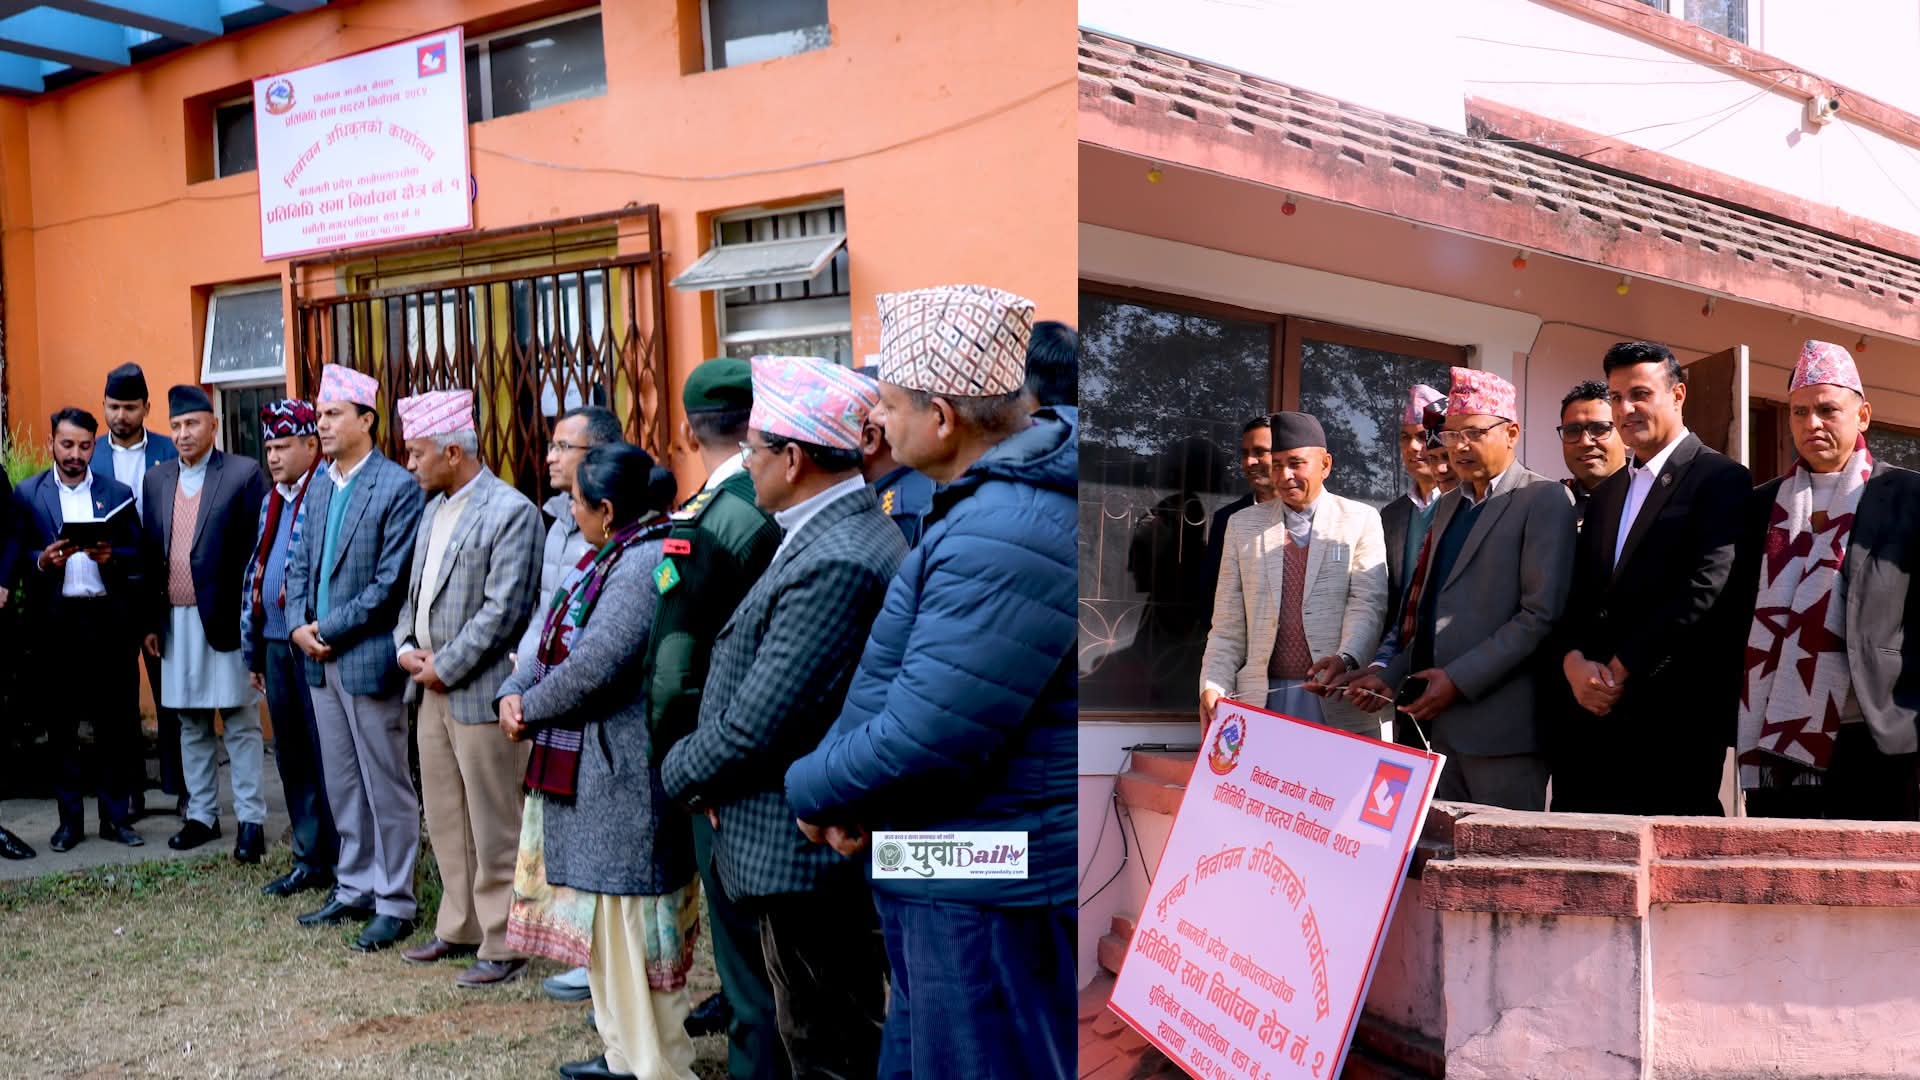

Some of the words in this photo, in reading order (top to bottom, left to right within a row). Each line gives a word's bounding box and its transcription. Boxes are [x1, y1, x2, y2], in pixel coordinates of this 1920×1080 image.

[283, 140, 321, 189] निर्वाचन
[326, 117, 383, 146] अधिकृतको
[388, 122, 436, 162] कार्यालय
[266, 200, 314, 225] प्रतिनिधि
[318, 197, 344, 216] सभा
[347, 188, 397, 210] निर्वाचन
[402, 182, 427, 201] क्षेत्र
[1213, 781, 1247, 811] प्रतिनिधि
[1246, 796, 1265, 818] सभा
[1265, 804, 1294, 830] सदस्य
[1292, 811, 1332, 848] निर्वाचन
[1332, 833, 1361, 859] २०८२
[1250, 765, 1280, 791] निर्वाचन
[1279, 778, 1307, 801] आयोग
[1308, 787, 1335, 811] नेपाल
[1157, 873, 1190, 923] मुख्य
[1195, 843, 1246, 885] निर्वाचन
[1248, 841, 1306, 912] अधिकृतको
[1301, 903, 1330, 1023] कार्यालय
[1176, 918, 1208, 949] बागमती
[1206, 936, 1229, 962] प्रदेश
[1135, 927, 1182, 975] प्रतिनिधि
[1181, 959, 1208, 995] सभा
[1206, 971, 1260, 1031] निर्वाचन
[1257, 1008, 1291, 1053] क्षेत्र
[1289, 1034, 1310, 1067] नं.
[1311, 1050, 1325, 1078] २
[1157, 1019, 1186, 1052] स्थापना
[1179, 1008, 1231, 1056] नगरपालिका
[1231, 1047, 1250, 1073] वडा
